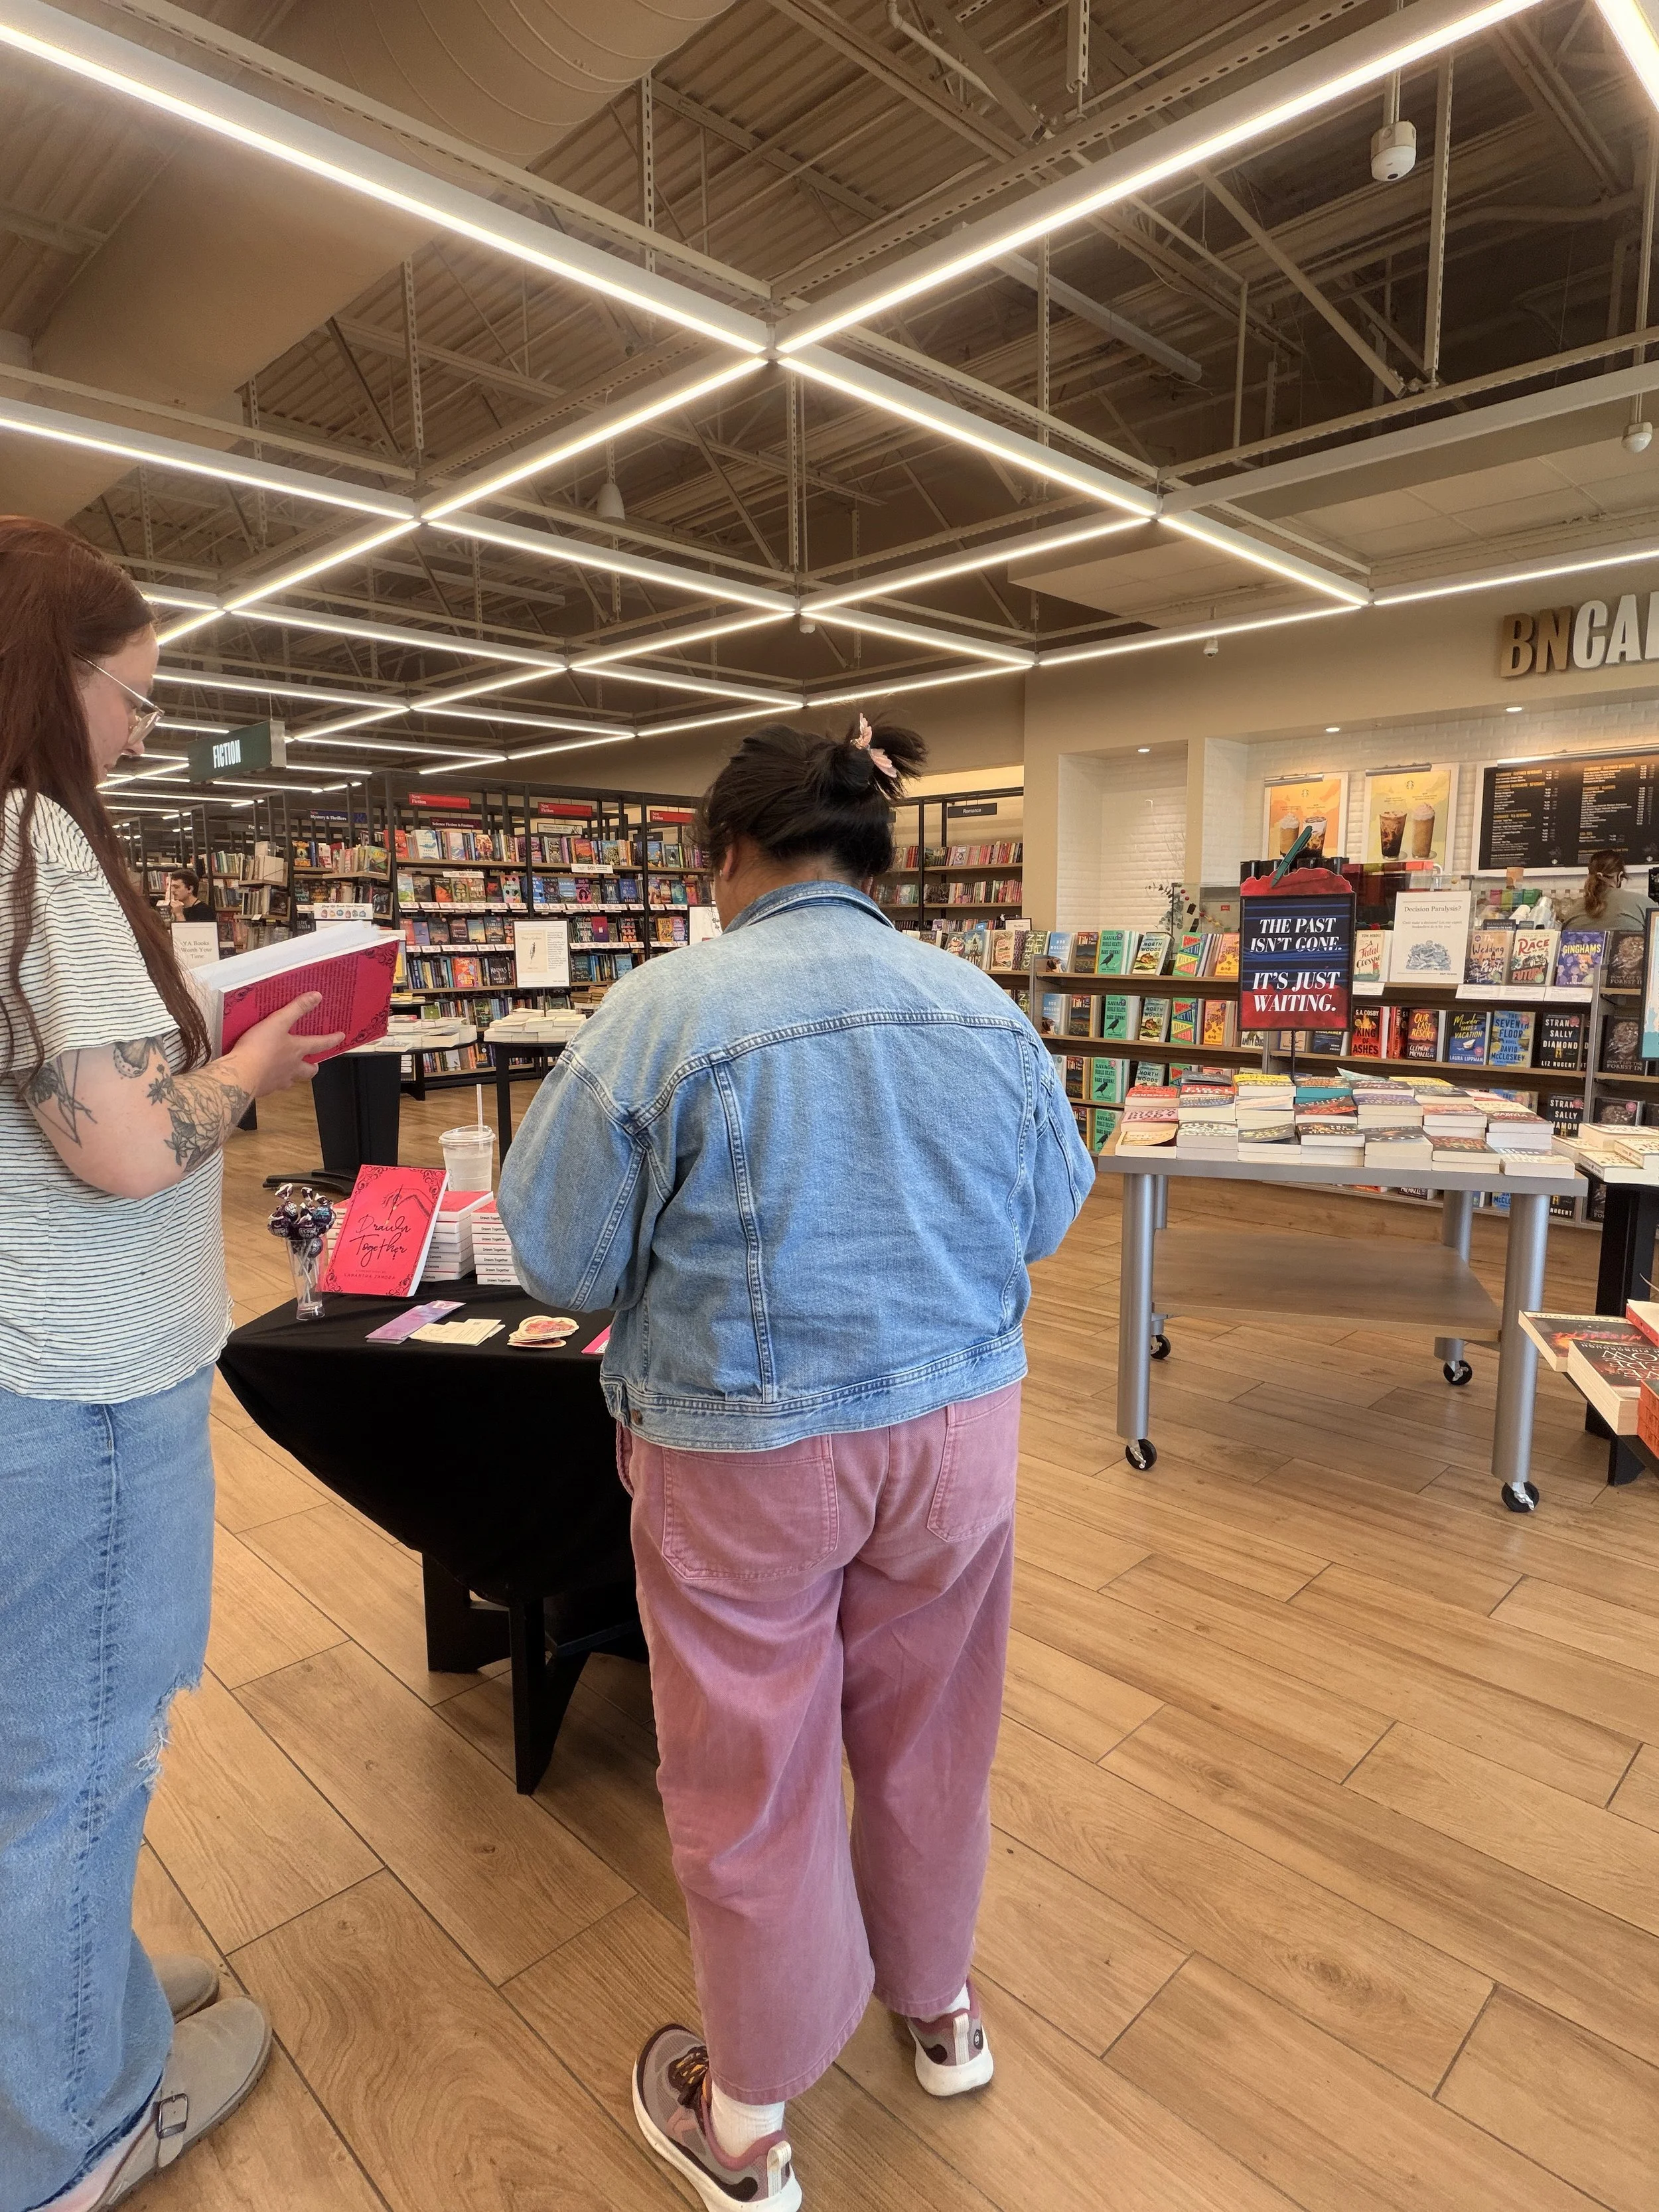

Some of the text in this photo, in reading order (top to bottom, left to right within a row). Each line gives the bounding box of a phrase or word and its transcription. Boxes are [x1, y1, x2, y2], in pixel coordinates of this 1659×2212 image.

[212, 739, 241, 769] FICTION
[1260, 917, 1336, 934] THE PAST
[1078, 935, 1088, 946] Tilt
[1250, 936, 1342, 953] ISN'T GONE.
[1023, 933, 1035, 967] GREEN
[1194, 944, 1200, 954] IT
[1358, 945, 1380, 959] Fatal
[1473, 943, 1504, 955] Wedding
[1518, 938, 1550, 956] RACE
[1563, 944, 1602, 954] GINGHAMS
[1252, 971, 1340, 992] IT'S JUST
[1072, 997, 1082, 1008] Tilt
[1254, 994, 1336, 1012] WAITING.
[1187, 1010, 1192, 1021] IT
[1413, 1013, 1429, 1023] OUR
[1453, 1013, 1480, 1027] Murder
[1495, 1019, 1530, 1029] SEVENTH
[1357, 1028, 1376, 1038] KING
[1411, 1028, 1435, 1039] RESORT
[1499, 1029, 1524, 1039] FLOOR
[1352, 1044, 1379, 1055] ASHES
[1543, 1040, 1578, 1049] DIAMOND
[1491, 1053, 1525, 1061] McCLOSKEY
[1555, 1110, 1577, 1120] SALLY
[1550, 1207, 1572, 1217] NUGENT
[356, 1213, 411, 1234] Drawn
[349, 1232, 408, 1267] Together
[1581, 1343, 1650, 1353] PINBOROUGH
